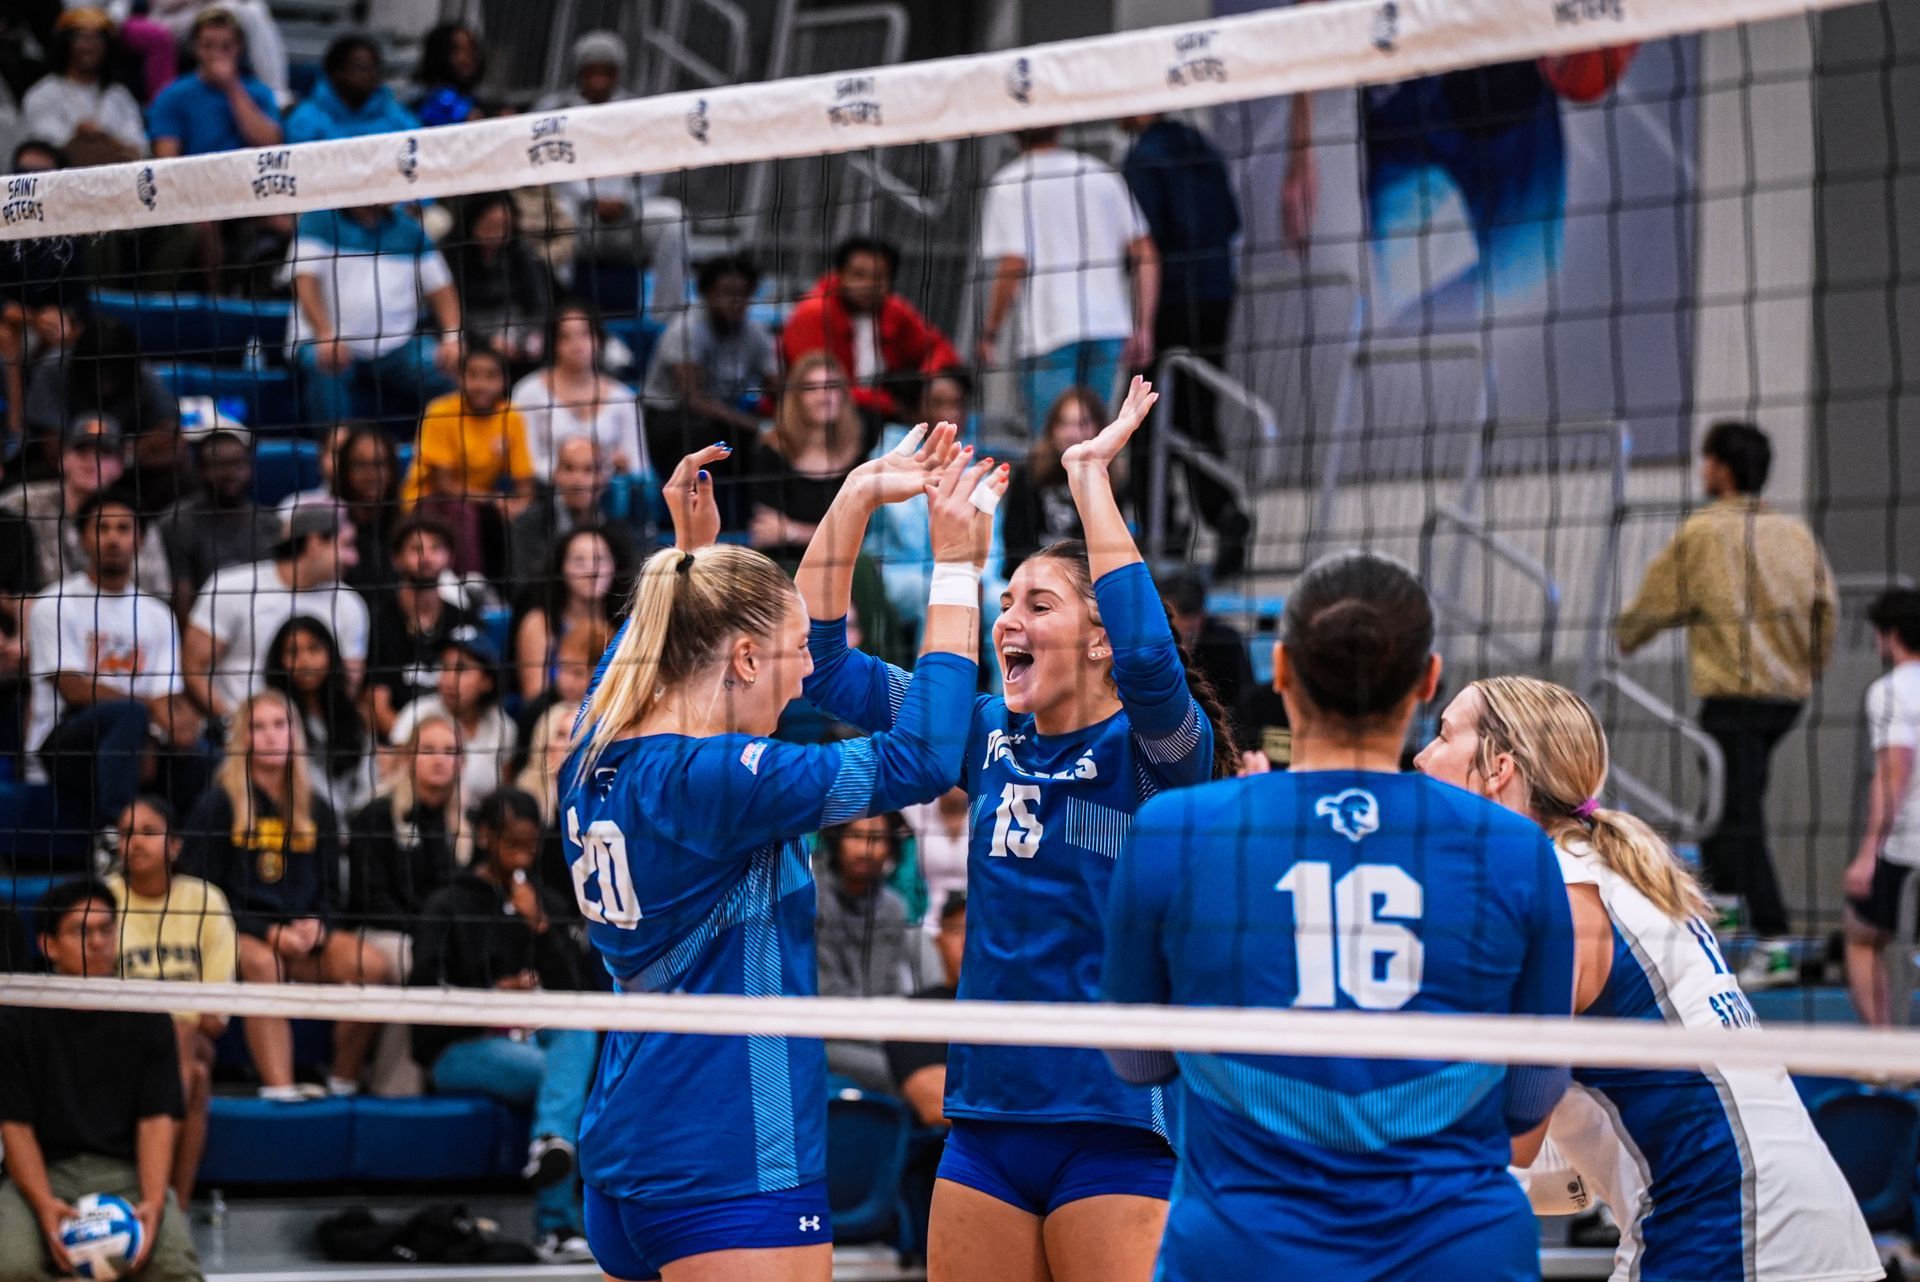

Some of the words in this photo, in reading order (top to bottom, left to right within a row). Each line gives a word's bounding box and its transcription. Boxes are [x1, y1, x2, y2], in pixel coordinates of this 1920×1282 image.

[532, 115, 568, 141] SAINT
[258, 150, 291, 174] SAINT
[8, 177, 38, 200] SAINT
[988, 782, 1044, 859] 15
[567, 806, 643, 931] 20
[1274, 860, 1425, 1010] 16
